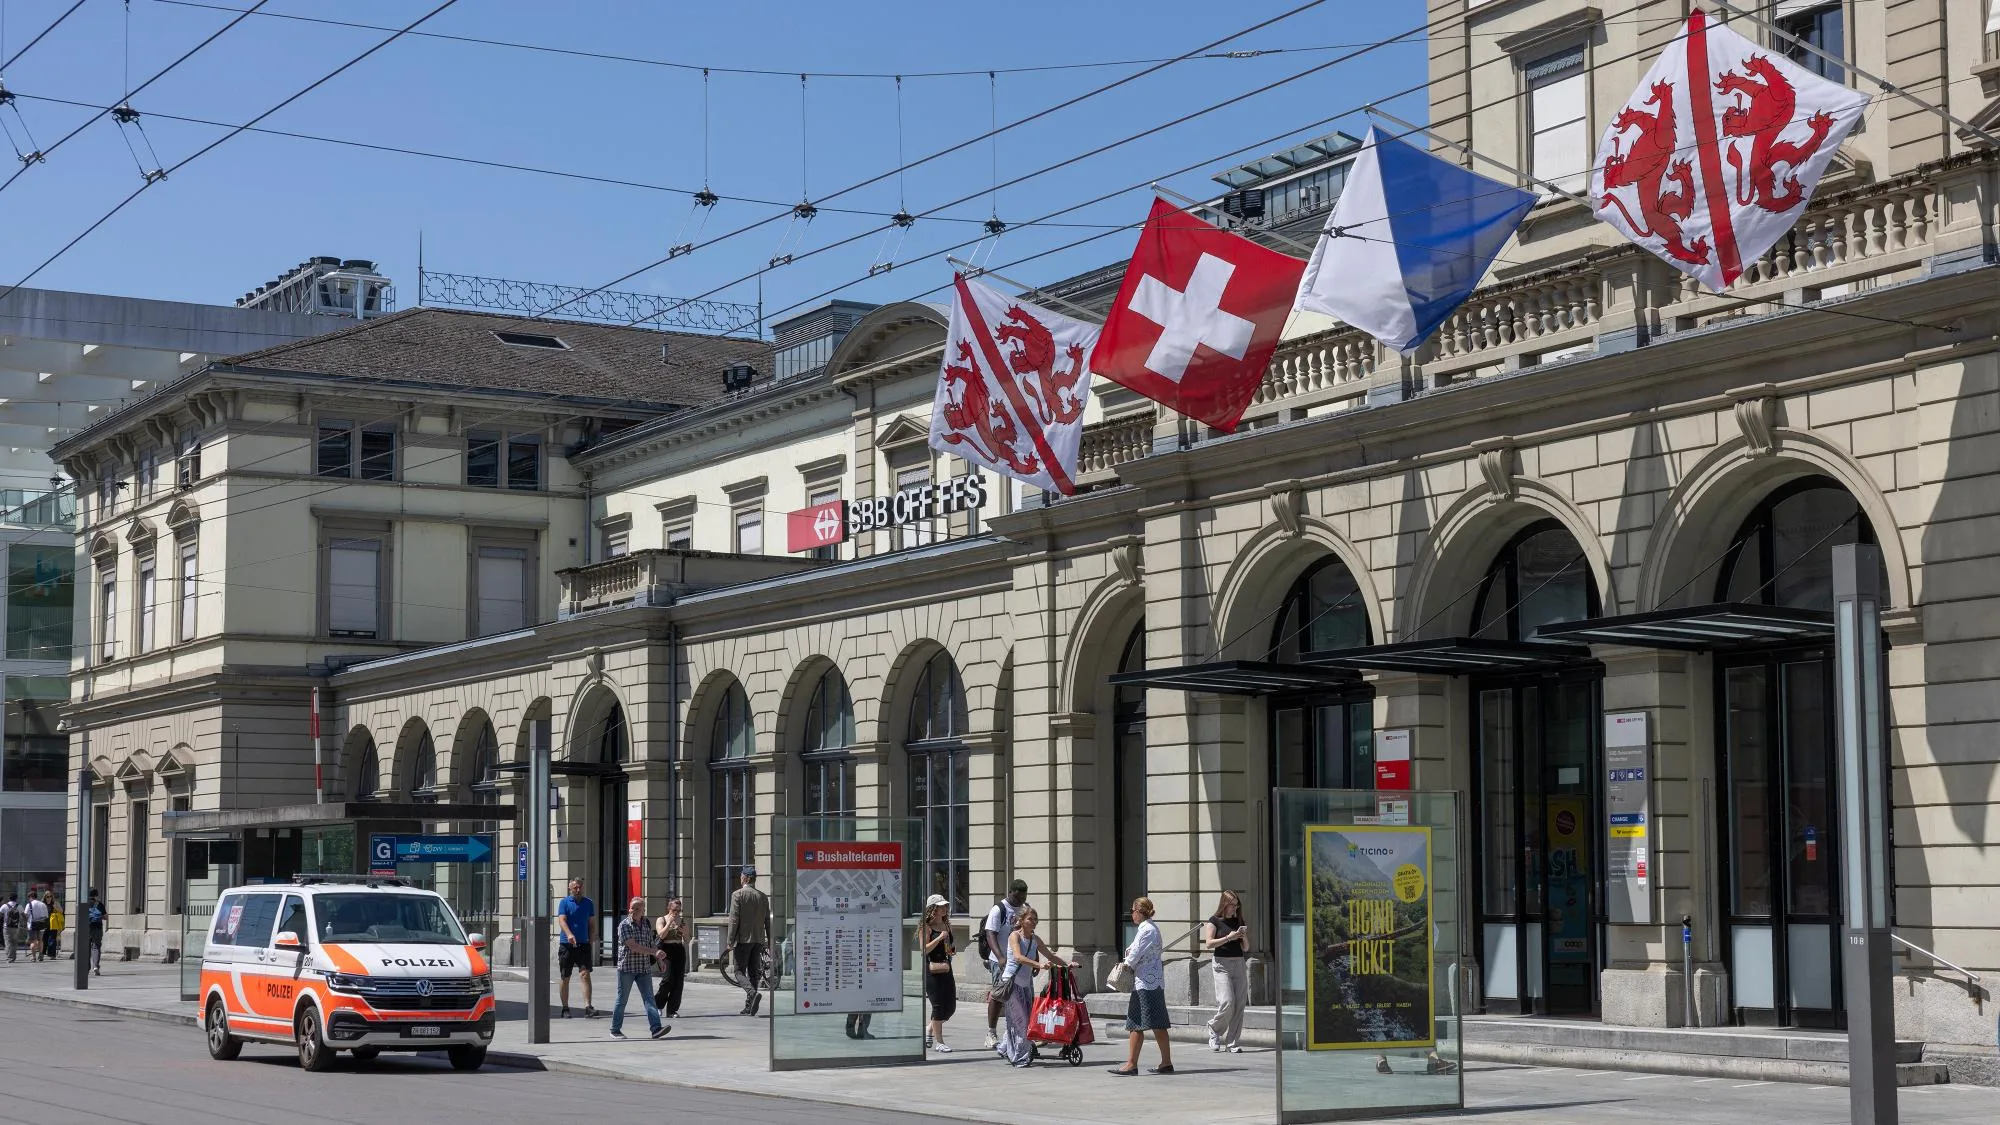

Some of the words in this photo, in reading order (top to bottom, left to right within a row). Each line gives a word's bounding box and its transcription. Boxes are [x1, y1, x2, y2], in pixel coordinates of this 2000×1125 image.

[848, 496, 889, 534] SBB
[893, 484, 934, 525] CFF
[939, 474, 984, 514] FFS
[376, 842, 391, 859] G
[817, 850, 895, 862] Bushaltekanten
[1360, 848, 1388, 856] TICINO
[1347, 900, 1394, 934] TICINO
[1850, 936, 1858, 945] 10
[304, 956, 314, 967] 201
[381, 958, 455, 968] POLIZEI
[1347, 940, 1395, 975] TICKET
[267, 983, 294, 1000] POLIZEI
